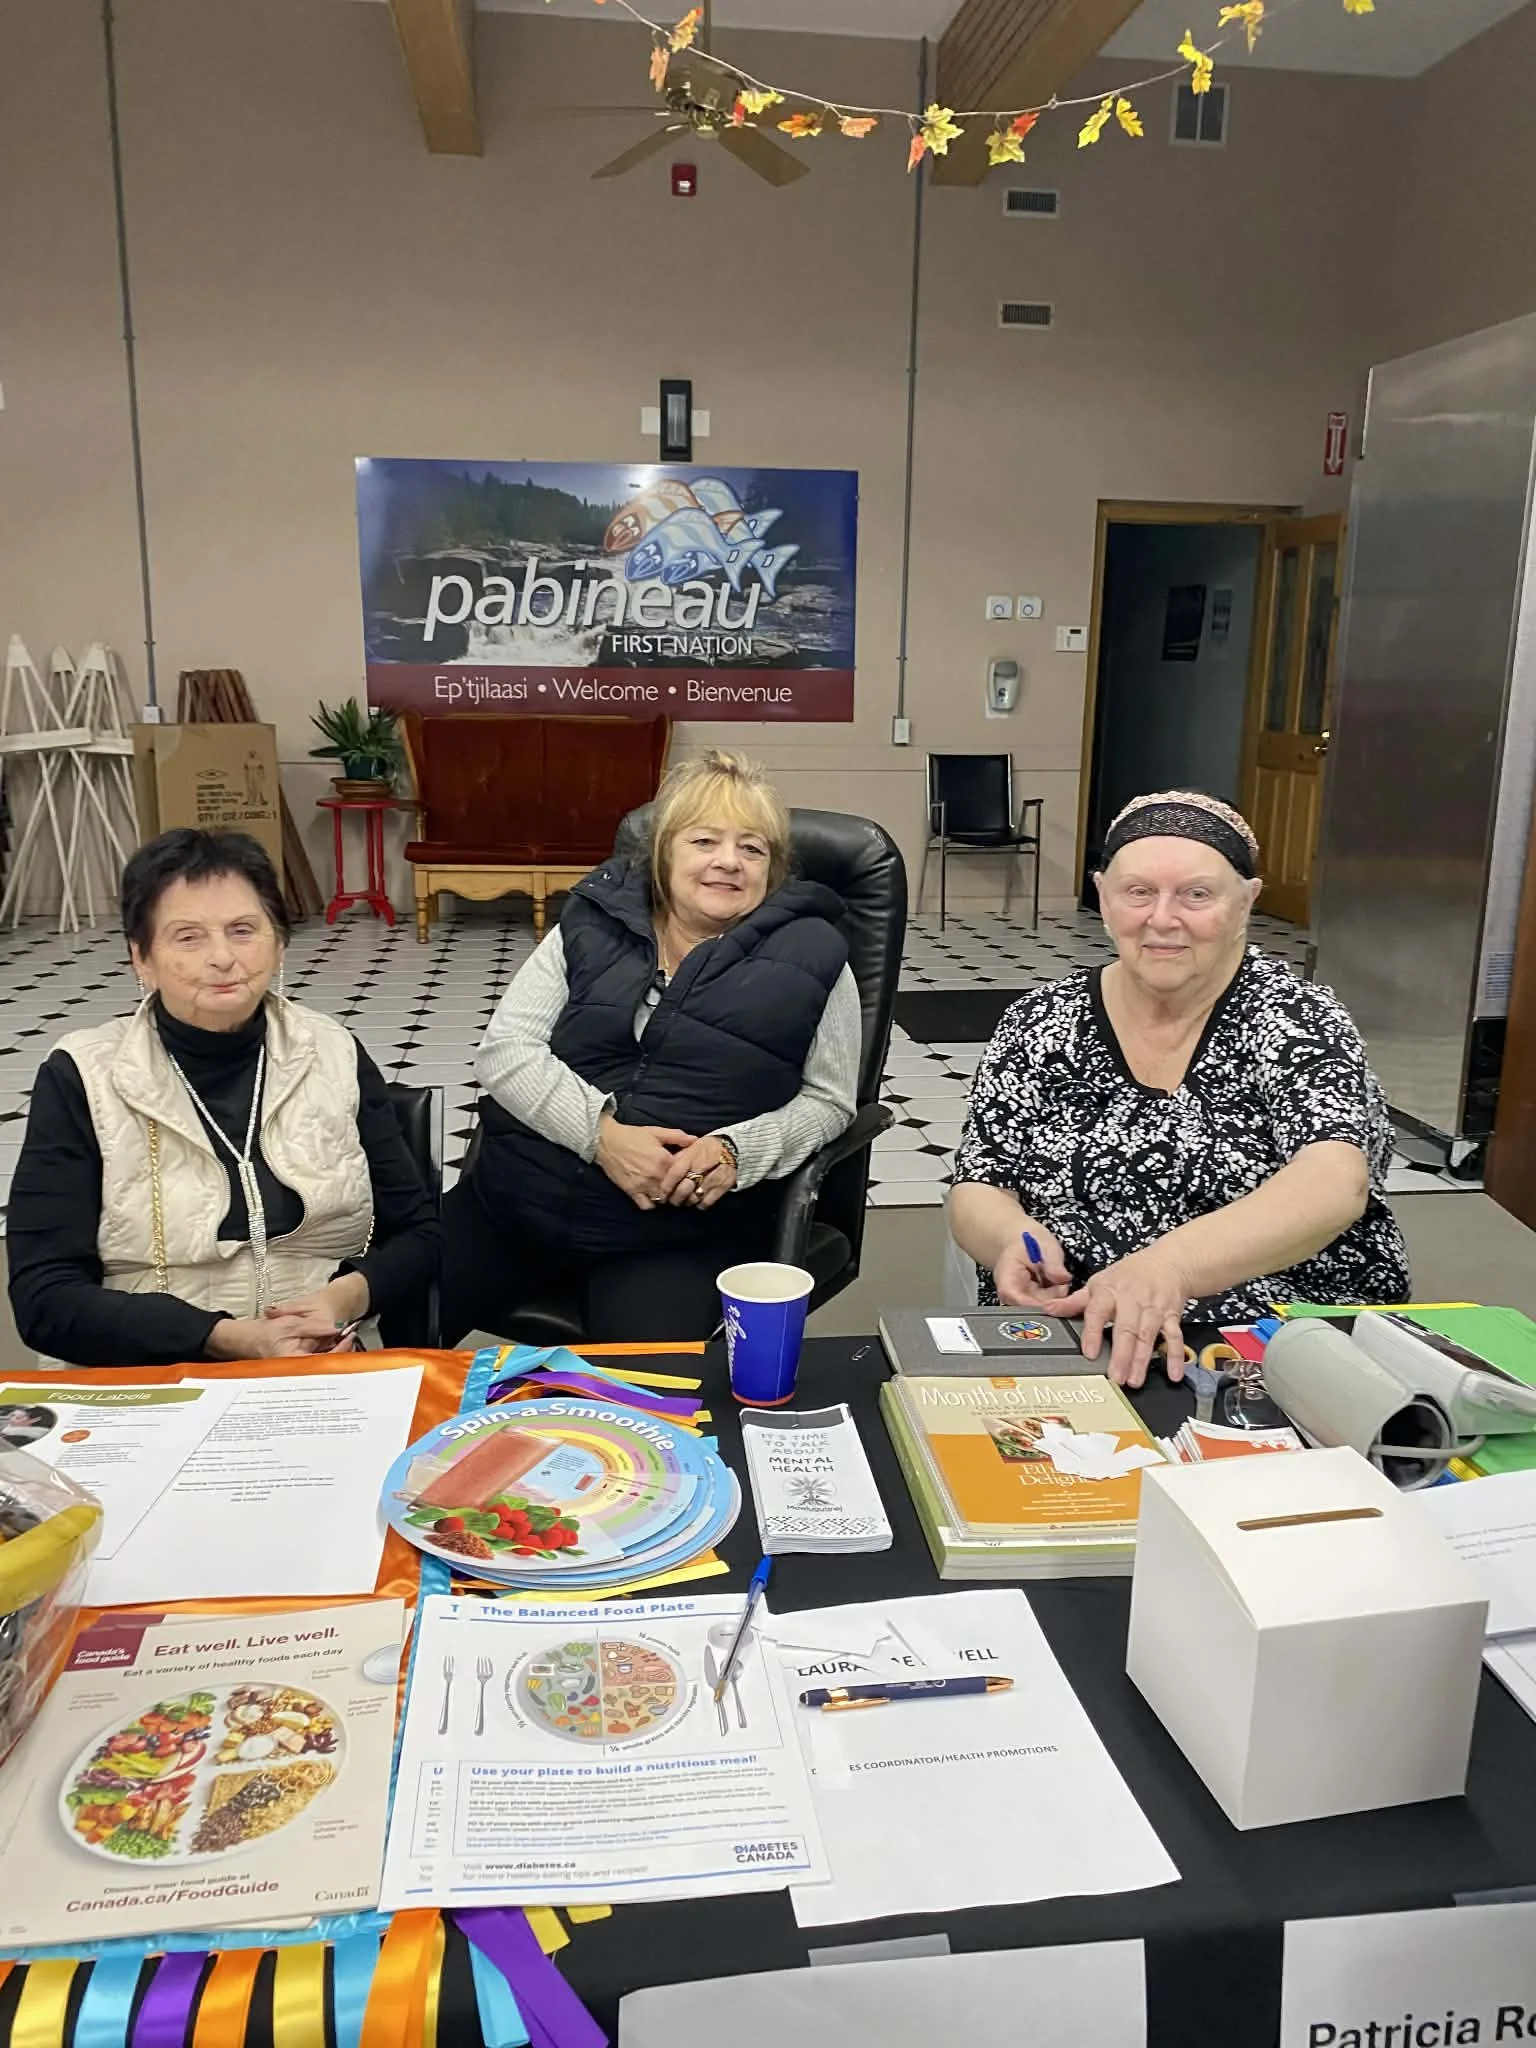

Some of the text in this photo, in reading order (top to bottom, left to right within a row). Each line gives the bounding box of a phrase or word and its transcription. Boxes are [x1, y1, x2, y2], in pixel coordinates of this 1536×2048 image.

[422, 556, 761, 642] pabineau
[612, 634, 753, 656] FIRST NATION
[553, 678, 659, 702] Welcome
[686, 678, 793, 703] Bienvenue
[47, 1392, 153, 1401] Food Labels
[920, 1384, 1106, 1406] Month of Meals
[439, 1402, 676, 1451] Spin-a-Smoothie
[791, 1432, 830, 1441] TIME
[791, 1440, 831, 1448] TALK
[772, 1447, 825, 1455] ABOUT
[768, 1456, 835, 1464] MENTAL
[772, 1465, 835, 1473] HEALTH
[480, 1601, 696, 1618] The Balanced Food Plate
[154, 1627, 340, 1657] Eat well. Live well.
[74, 1653, 132, 1665] food guide
[77, 1647, 126, 1658] Canada's
[123, 1669, 144, 1678] Eat
[155, 1662, 196, 1675] variety
[198, 1661, 211, 1670] of
[212, 1656, 256, 1670] healthy
[258, 1653, 291, 1664] foods
[293, 1649, 321, 1661] each
[322, 1647, 344, 1657] day
[471, 1754, 757, 1778] Use your plate to build a nutritious meal!
[863, 1751, 986, 1771] COORDINATOR/HEALTH
[986, 1744, 1059, 1759] PROMOTIONS
[733, 1841, 798, 1855] DIABETES
[485, 1861, 577, 1870] www.diabetes.ca
[736, 1850, 798, 1864] CANADA
[592, 1869, 611, 1877] and
[103, 1883, 151, 1895] Discover
[153, 1880, 178, 1891] your
[180, 1876, 206, 1887] food
[207, 1873, 237, 1885] guide
[65, 1879, 280, 1913] Canada.ca/FoodGuide
[314, 1886, 370, 1903] Canada
[1308, 2010, 1482, 2048] Patricia
